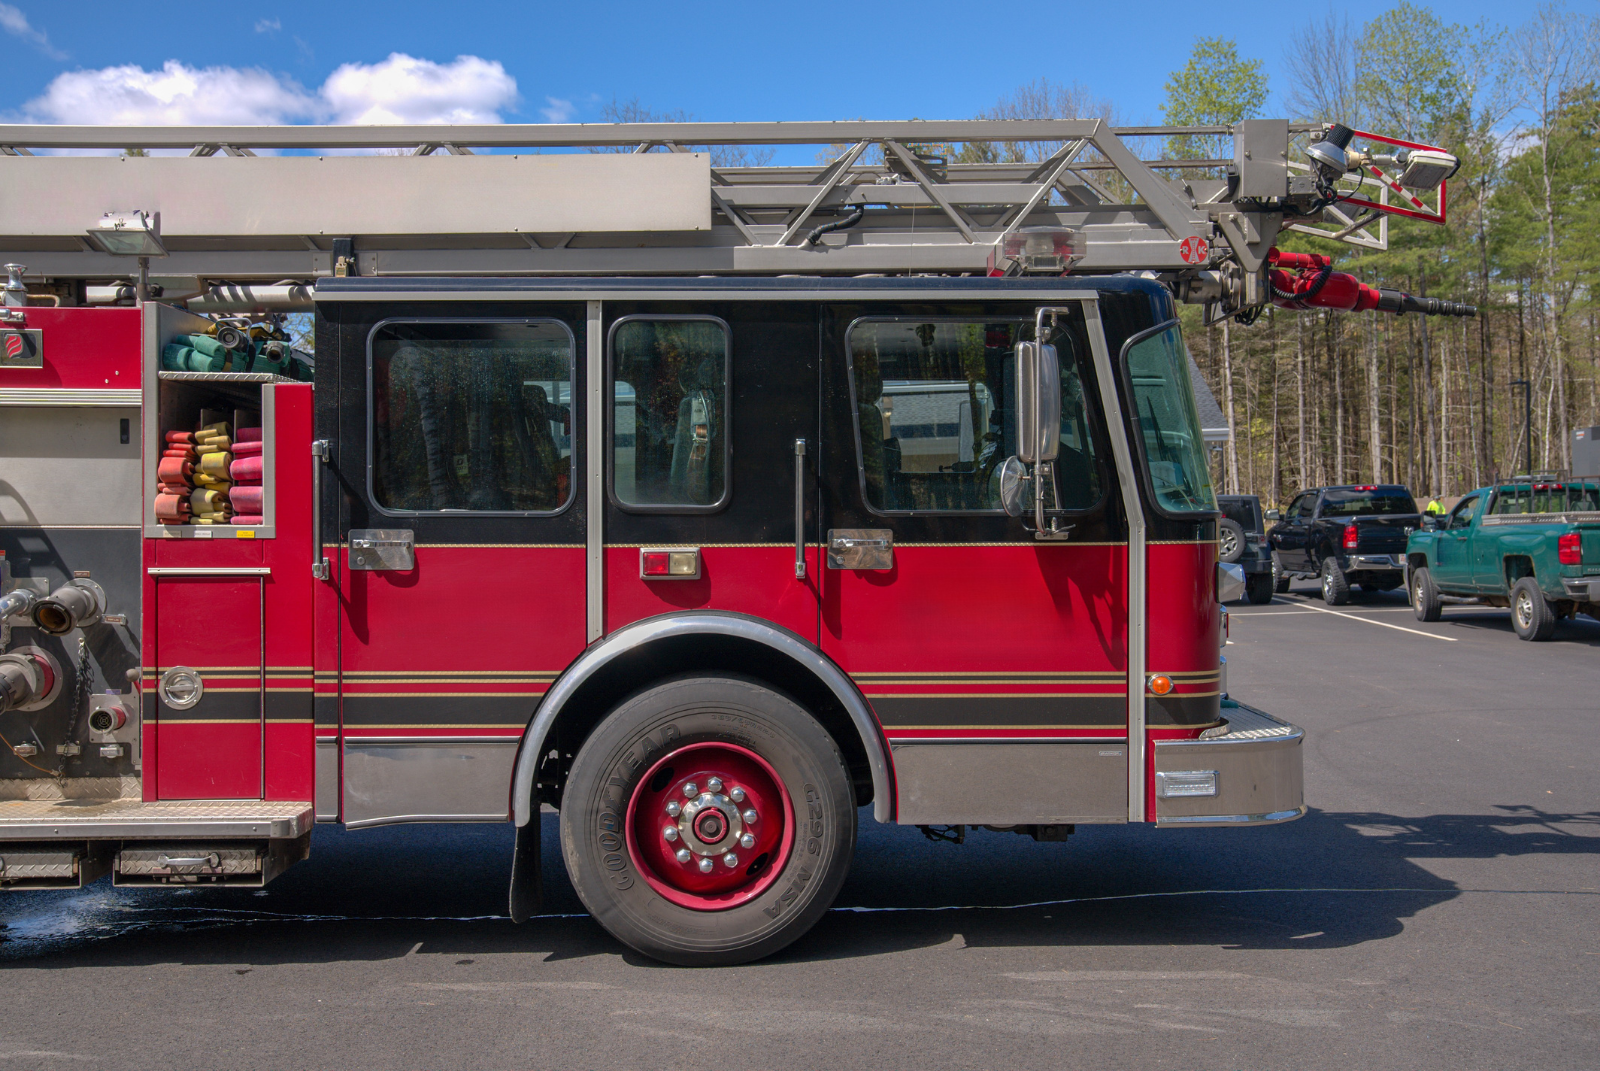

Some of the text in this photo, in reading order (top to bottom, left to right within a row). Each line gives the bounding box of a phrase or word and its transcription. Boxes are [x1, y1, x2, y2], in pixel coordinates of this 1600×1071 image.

[1182, 246, 1206, 254] R K
[599, 723, 682, 891] GOODYEAR
[803, 781, 824, 856] G296
[763, 867, 811, 920] MSA
